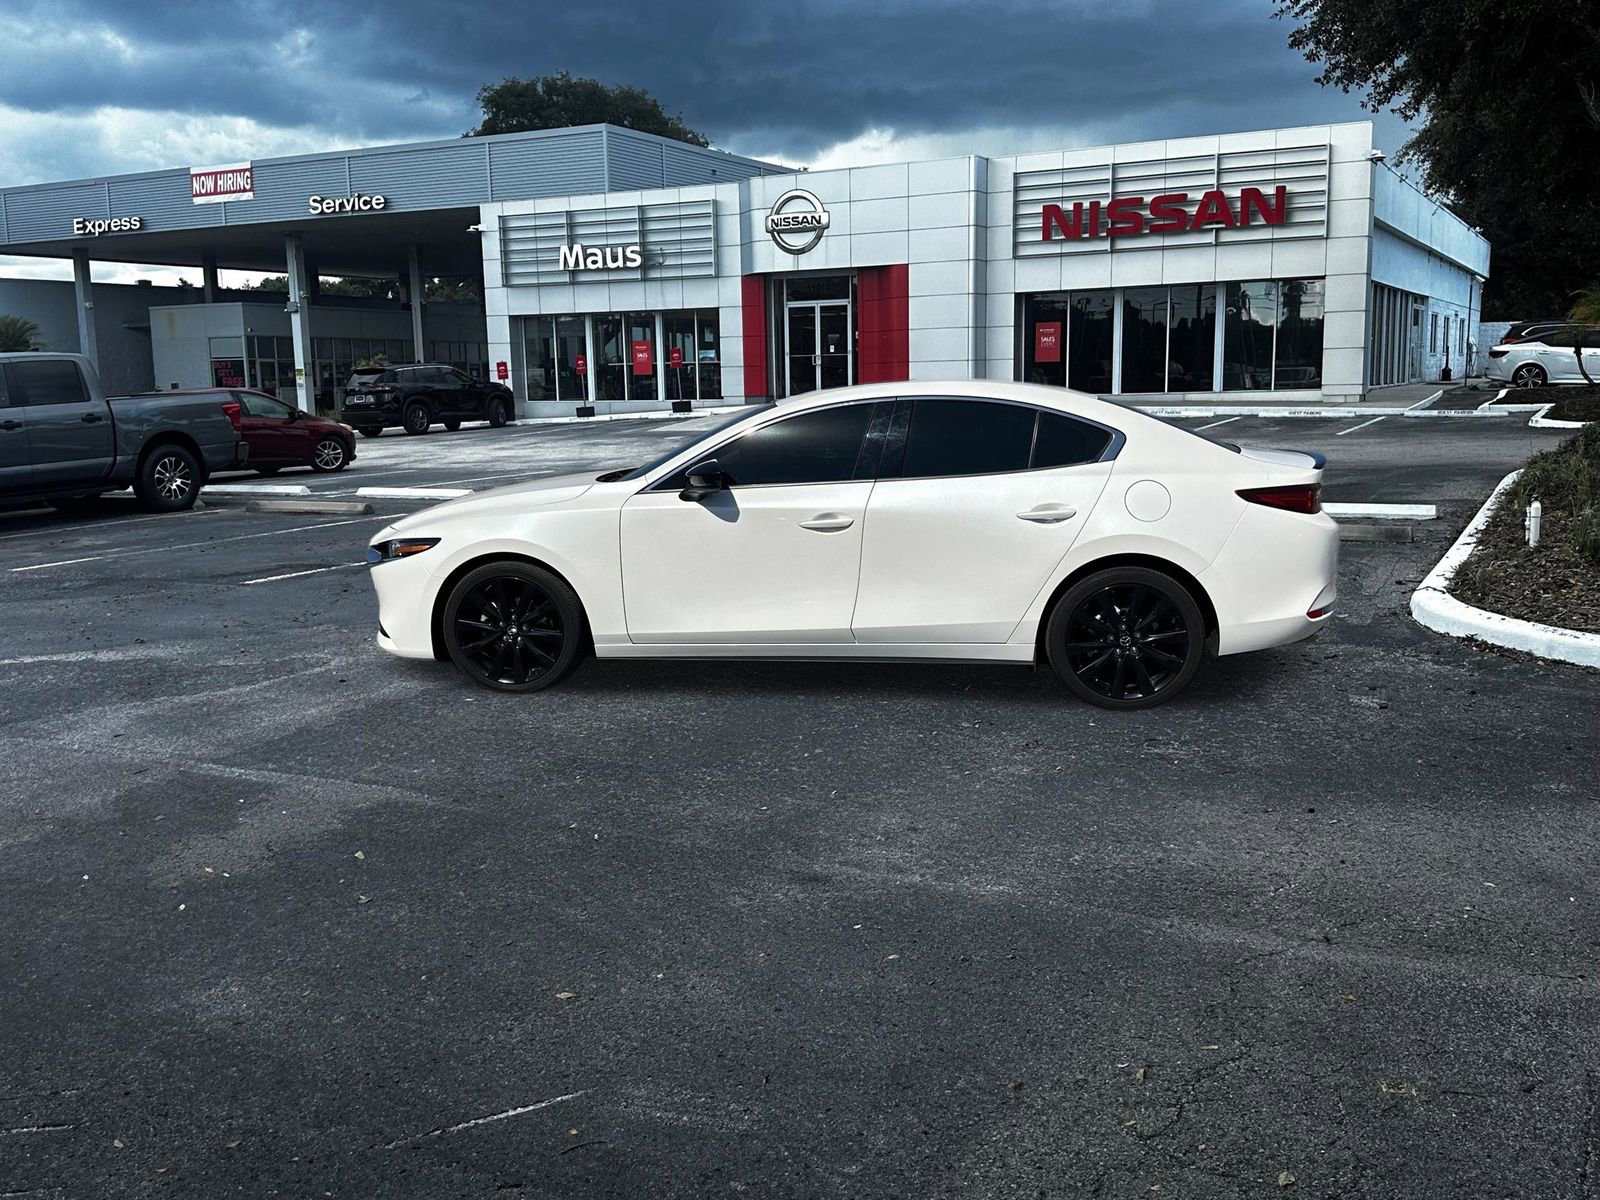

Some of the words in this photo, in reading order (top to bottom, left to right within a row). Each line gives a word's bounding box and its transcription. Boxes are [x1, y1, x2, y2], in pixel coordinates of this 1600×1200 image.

[192, 174, 215, 195] NOW
[217, 171, 251, 192] HIRING
[309, 193, 385, 215] Service
[1042, 185, 1287, 241] NISSAN
[73, 216, 141, 236] Express
[770, 214, 822, 229] NISSAN
[559, 243, 642, 271] Maus
[222, 377, 244, 387] FREE
